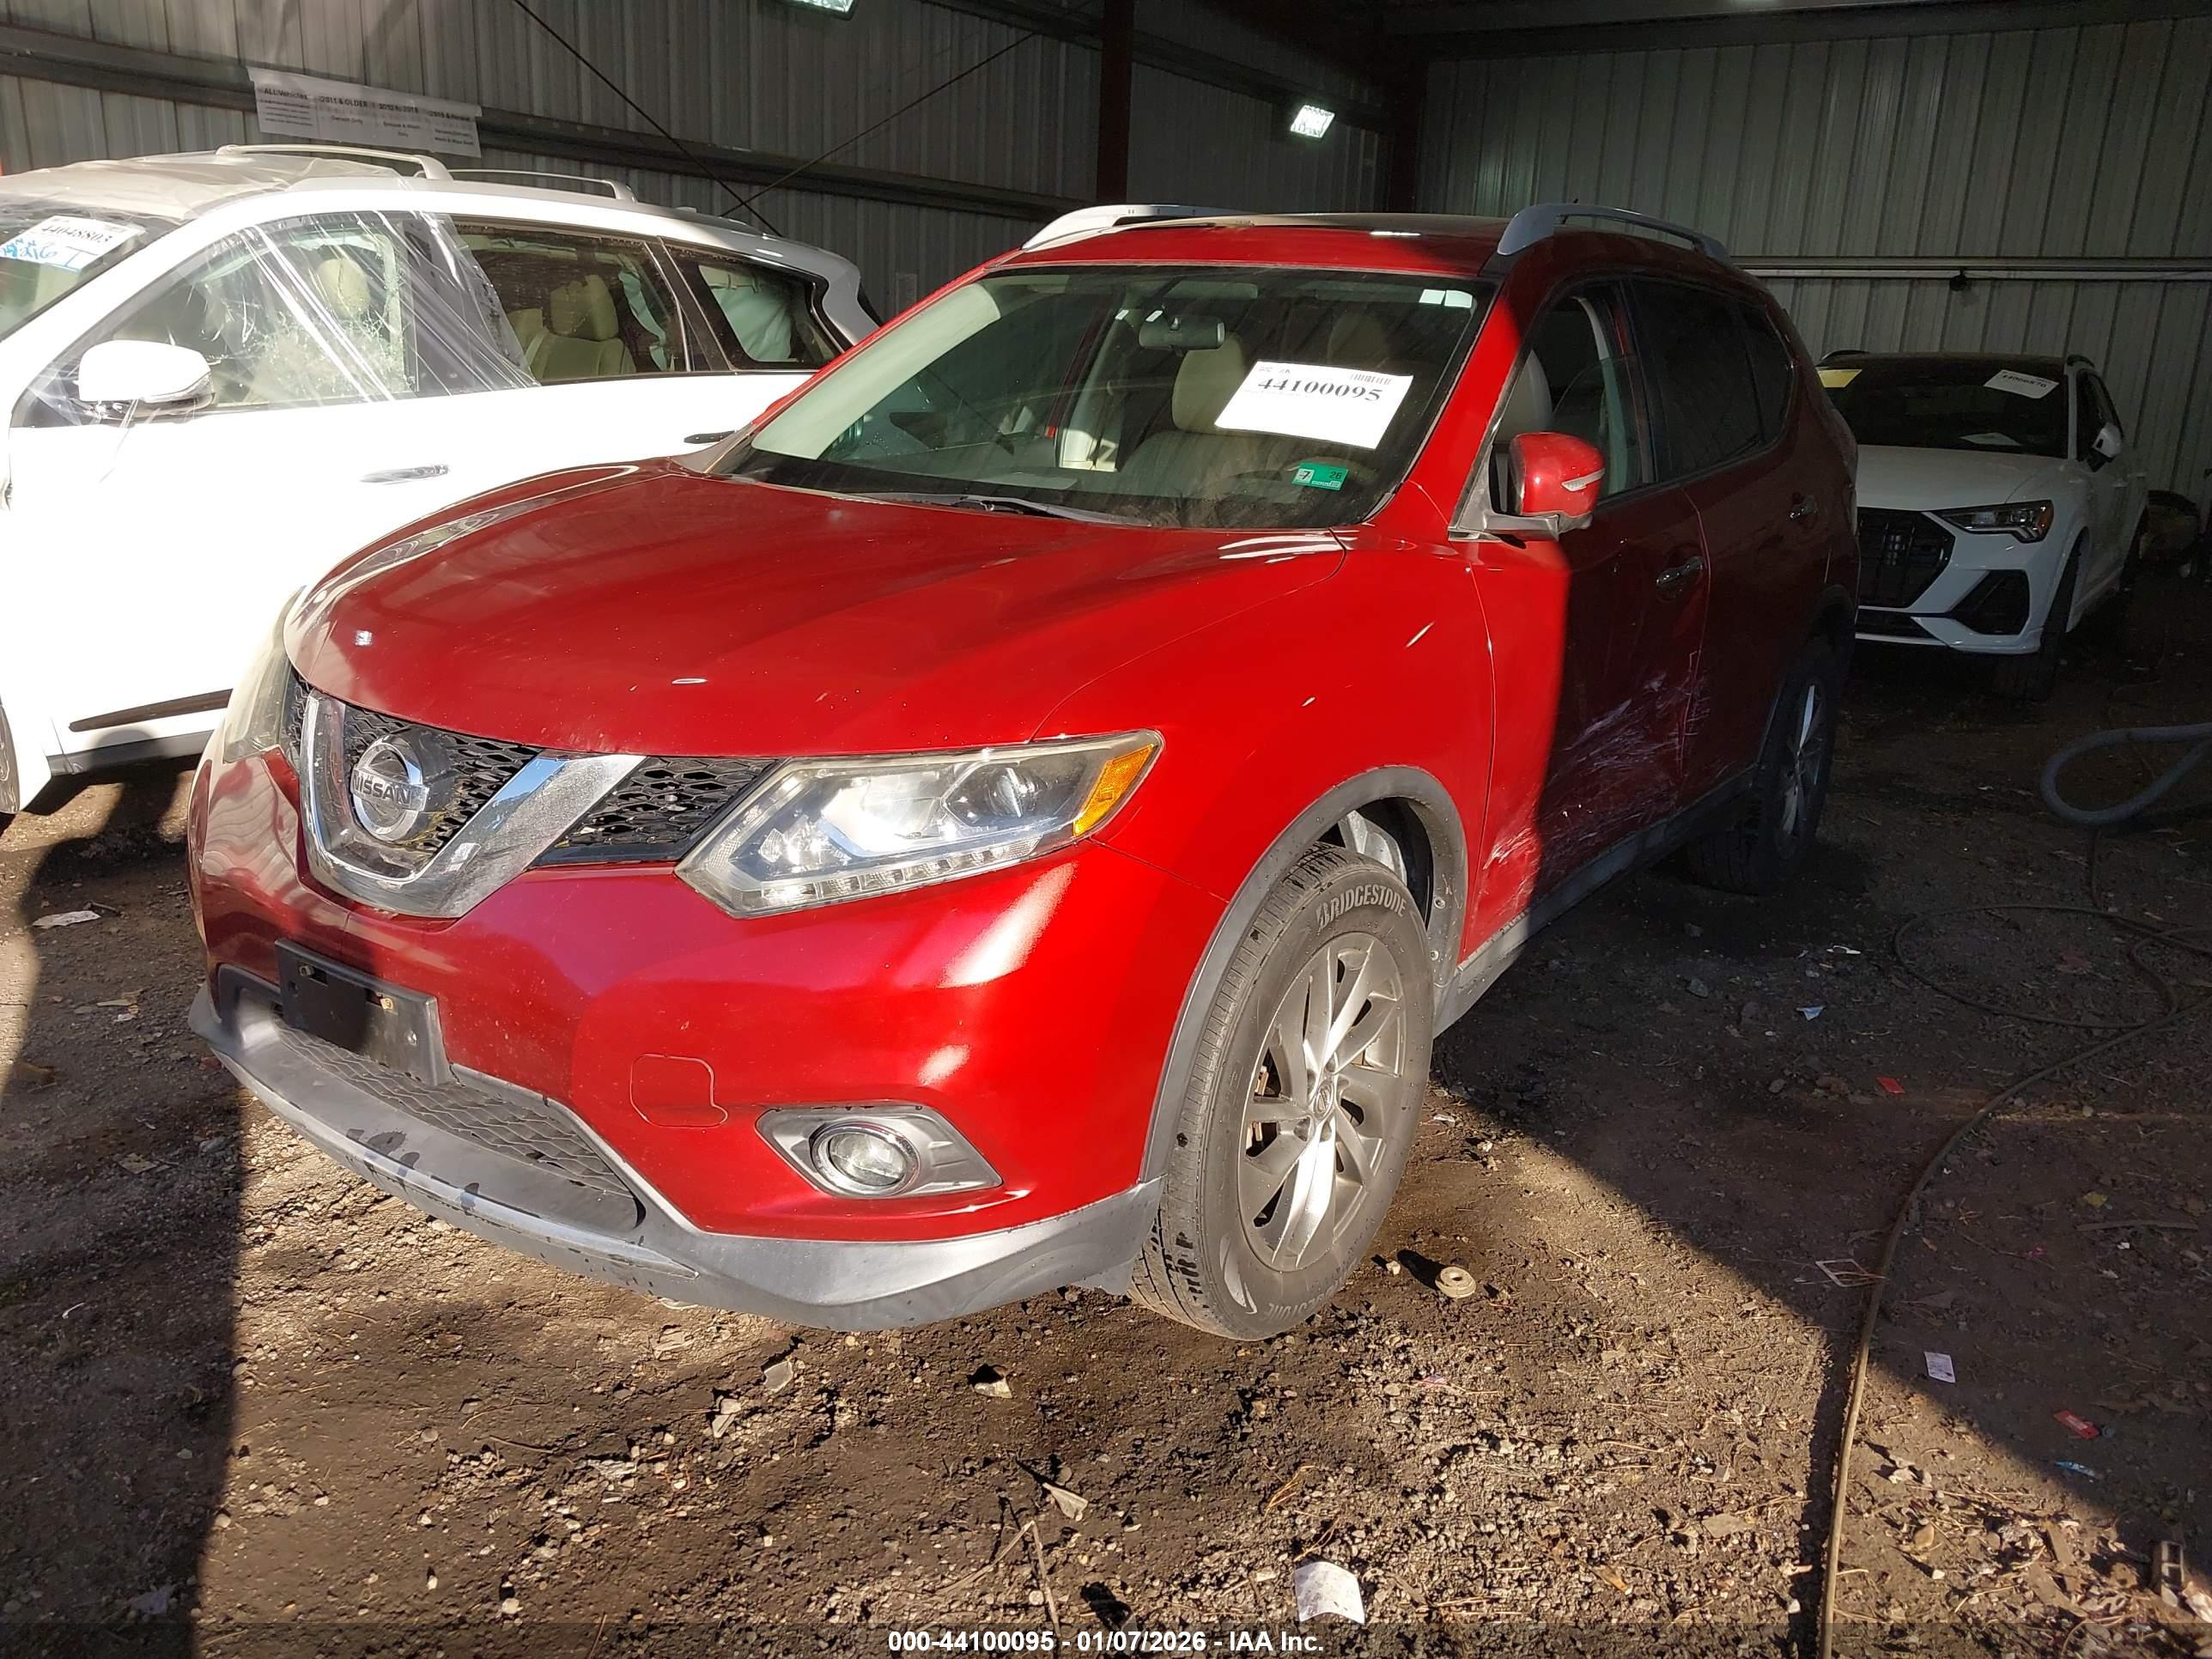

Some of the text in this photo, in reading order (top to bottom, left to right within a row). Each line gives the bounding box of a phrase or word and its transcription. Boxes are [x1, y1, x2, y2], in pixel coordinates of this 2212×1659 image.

[1257, 378, 1383, 402] 44100095
[352, 772, 412, 805] NISSAN
[1316, 884, 1407, 930] BRIDGESTONE
